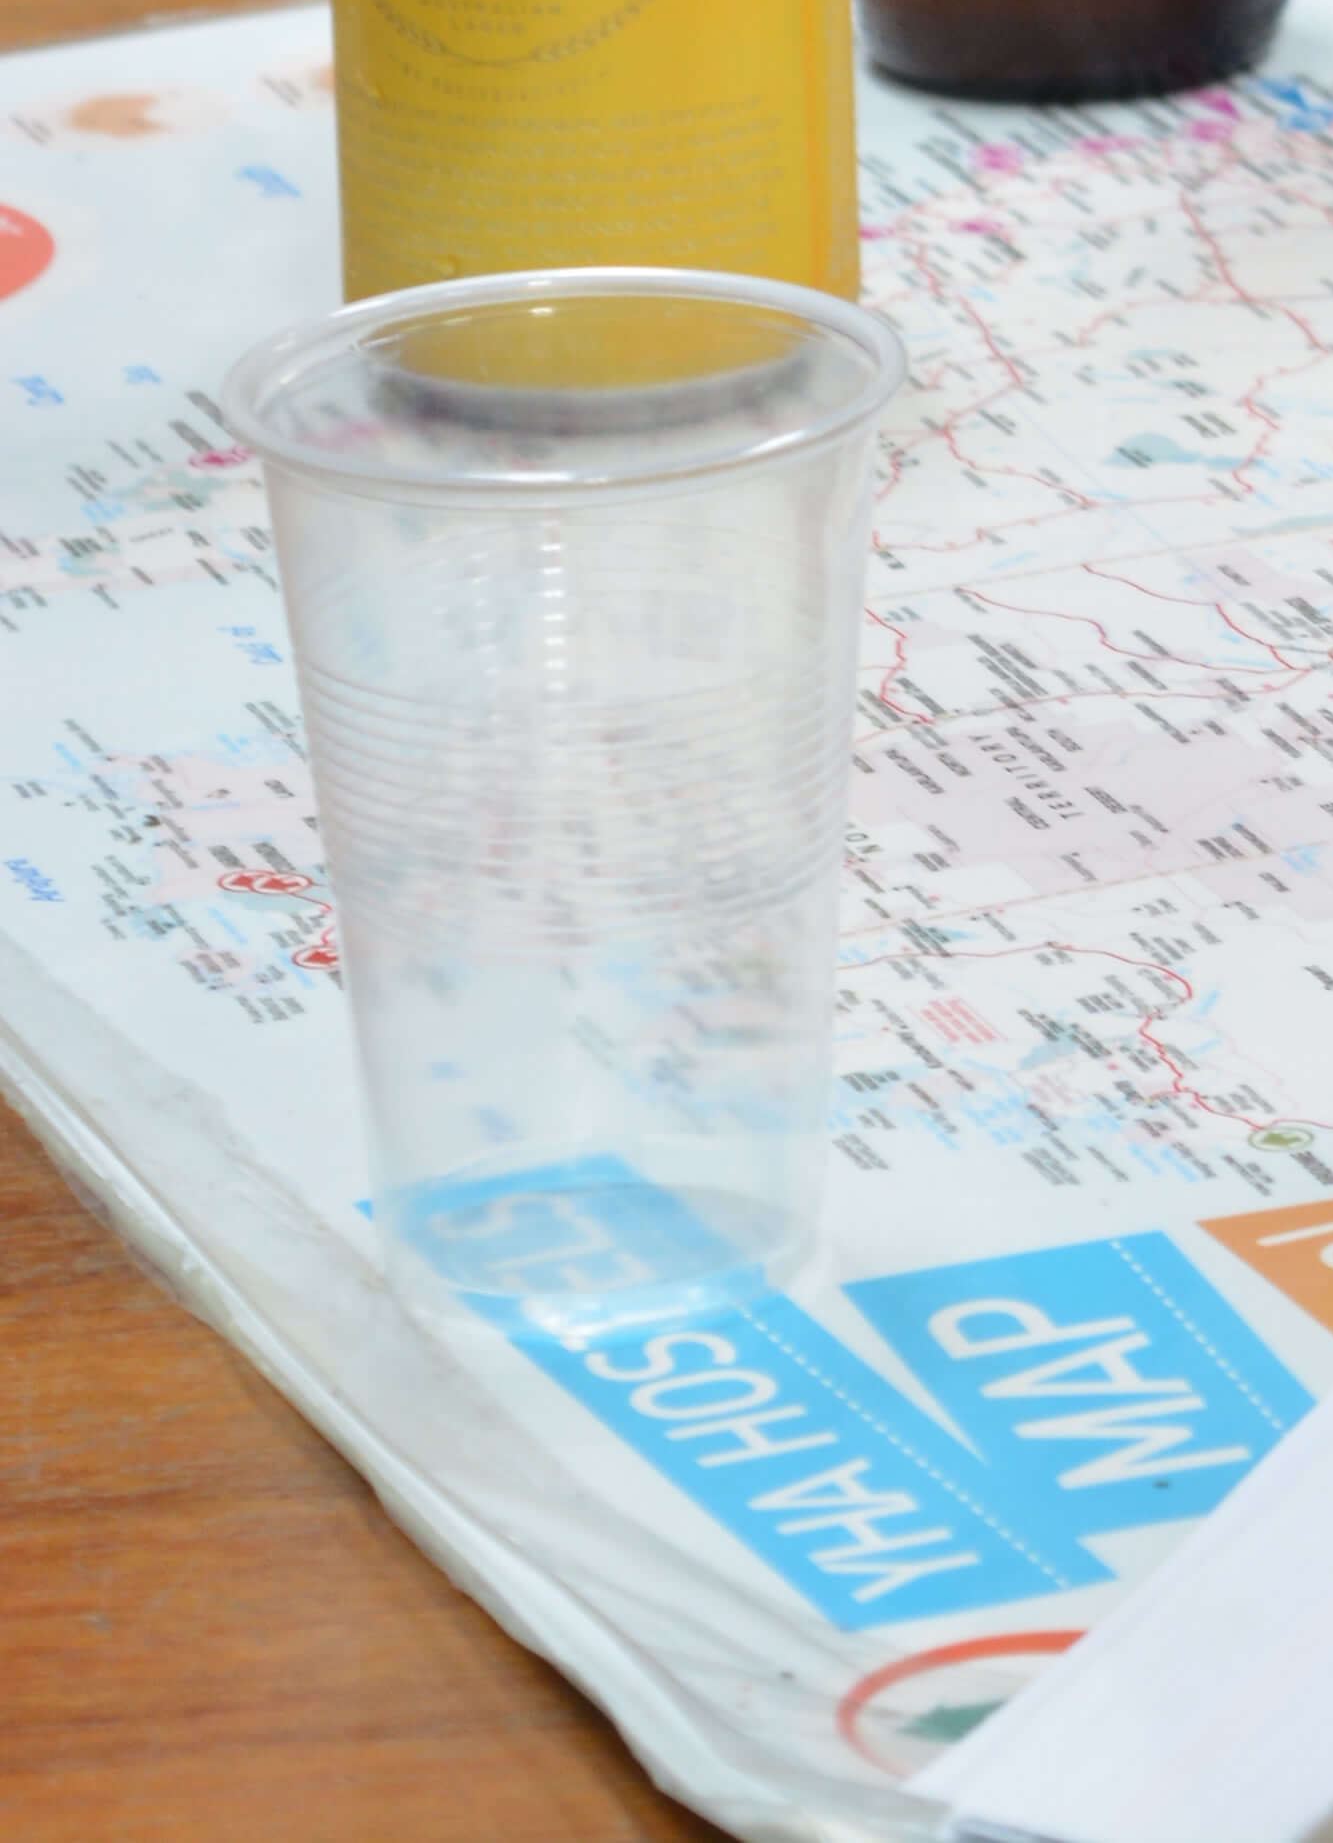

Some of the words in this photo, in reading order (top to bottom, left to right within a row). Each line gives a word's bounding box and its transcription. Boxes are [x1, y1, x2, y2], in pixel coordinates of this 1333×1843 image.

[968, 735, 1083, 819] TERRITORY
[430, 1188, 840, 1473] HOSTELS
[925, 1296, 1255, 1490] MAP
[742, 1454, 984, 1605] YHA
